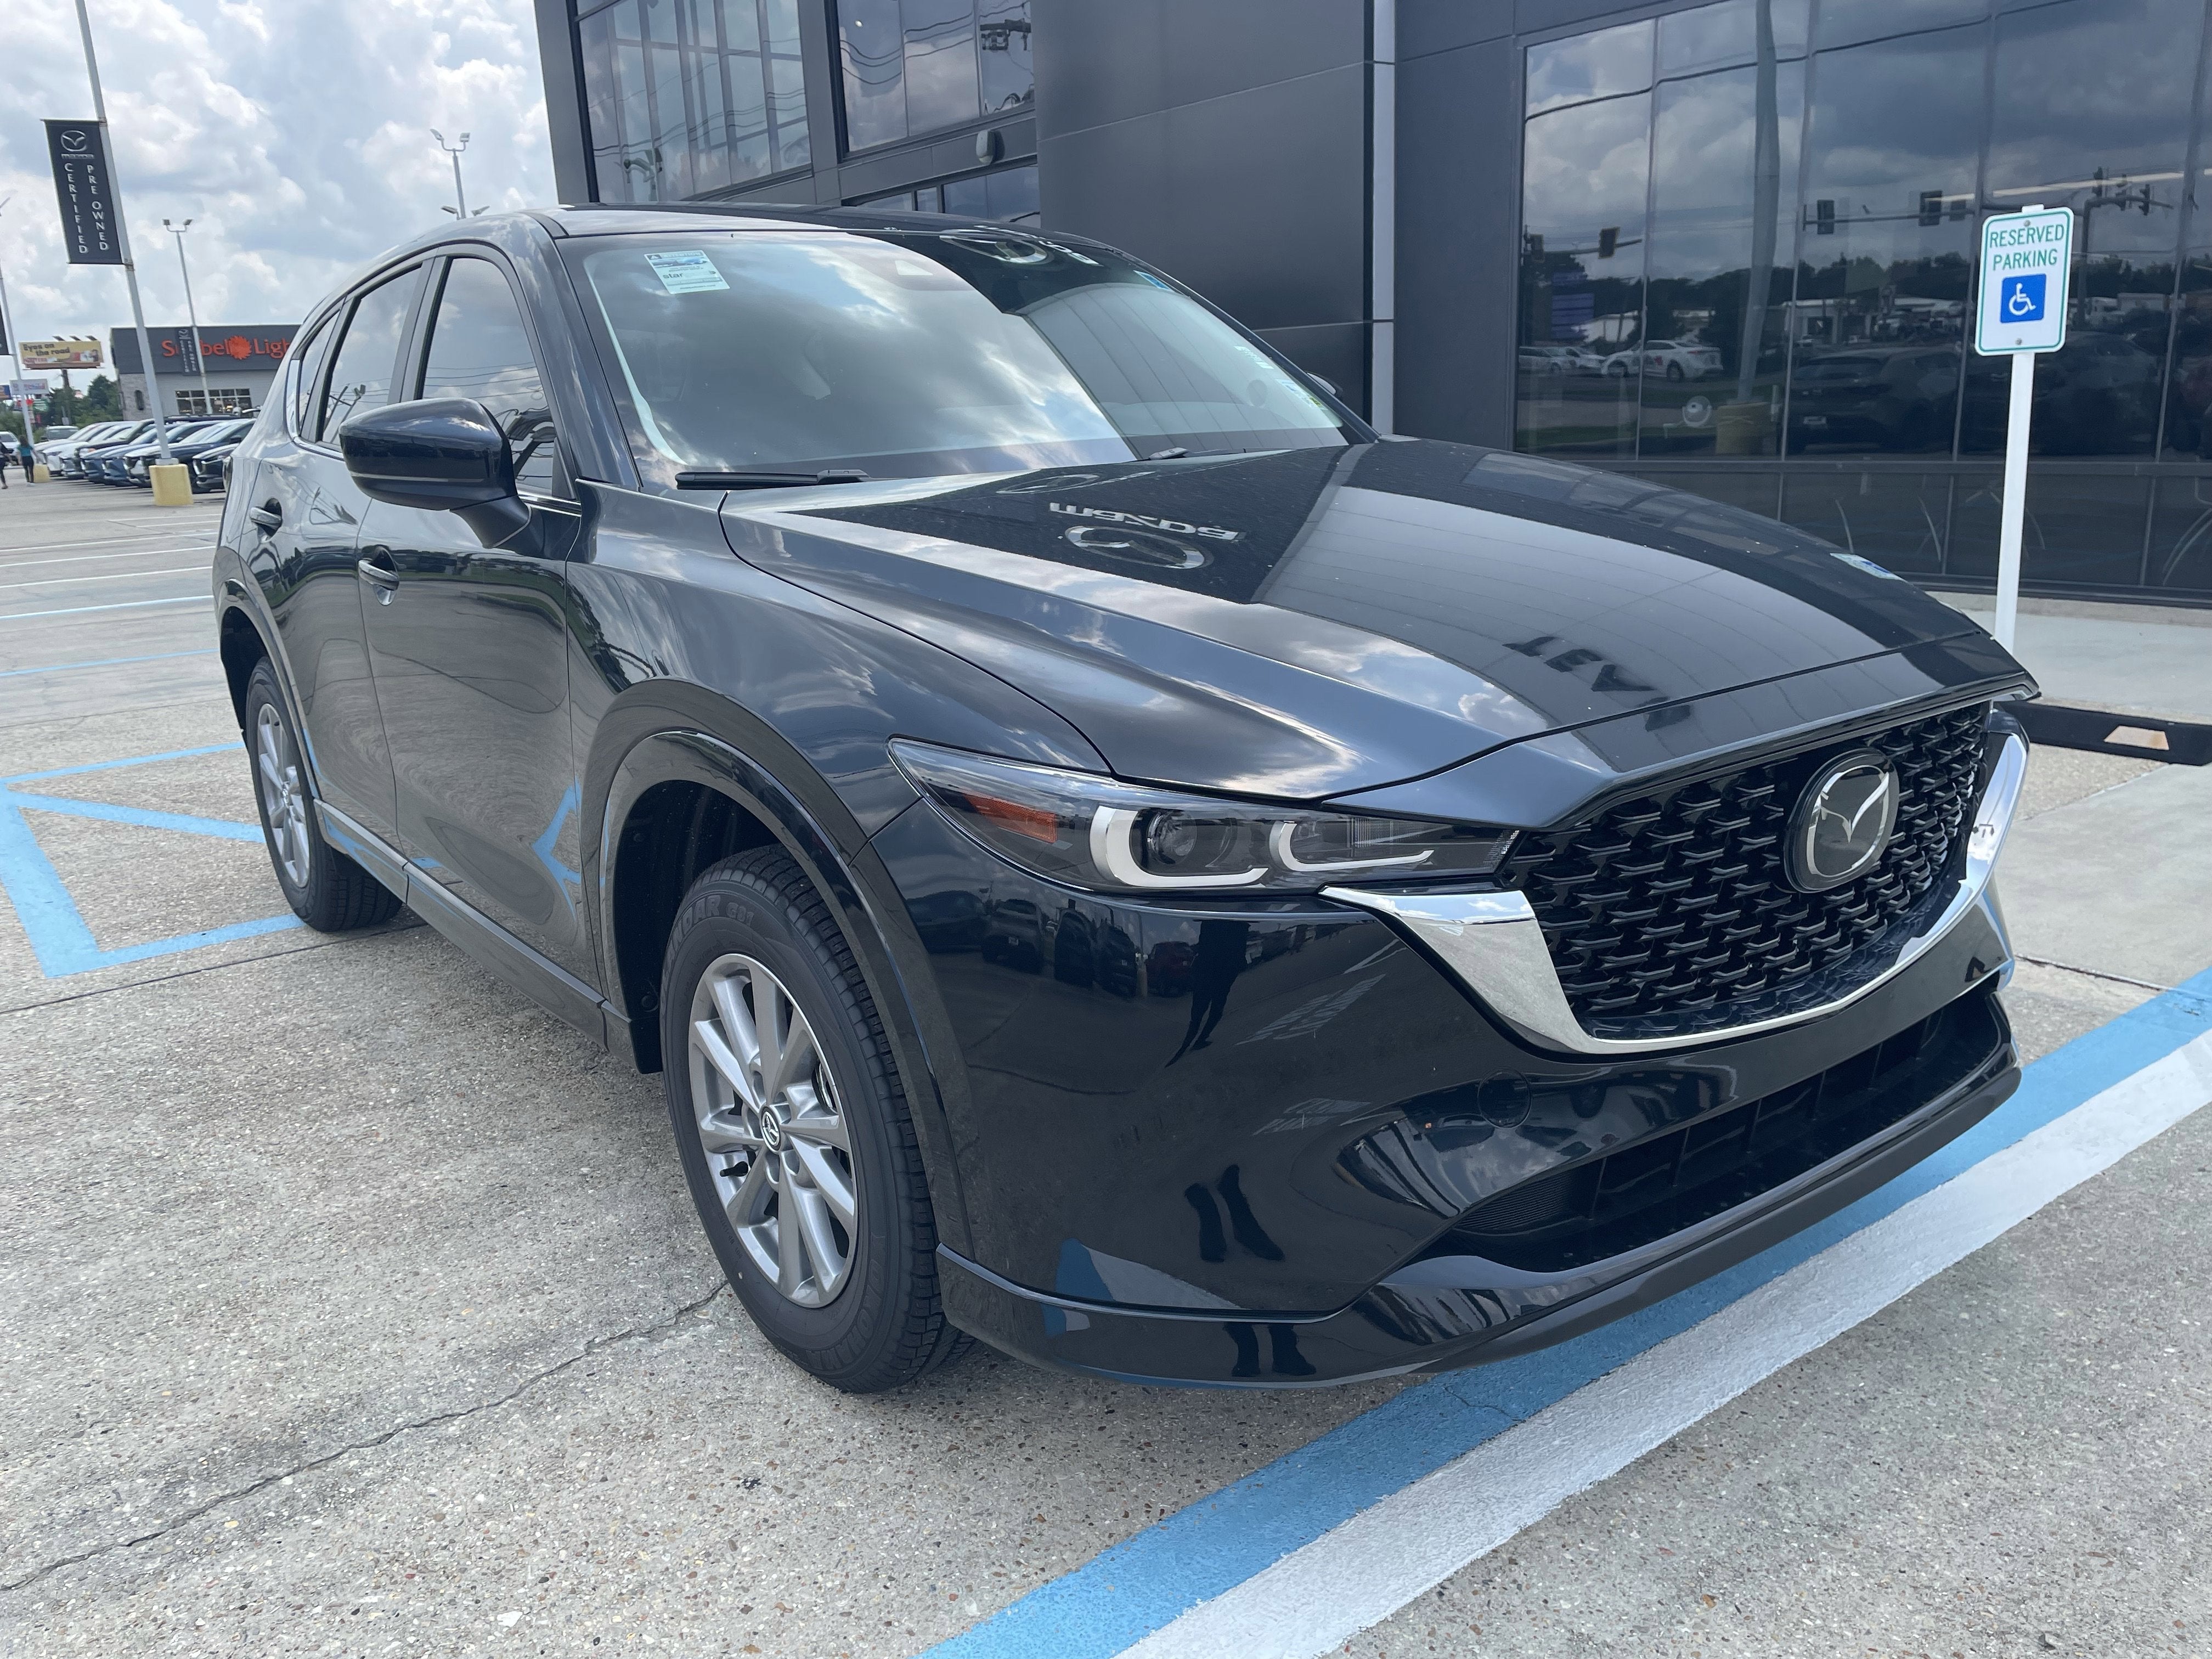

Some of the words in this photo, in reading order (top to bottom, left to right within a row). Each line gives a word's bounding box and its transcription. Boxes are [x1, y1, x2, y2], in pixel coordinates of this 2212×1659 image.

[64, 163, 88, 253] CERTIFIED
[87, 165, 97, 195] PRE
[92, 201, 109, 251] OWNED
[1990, 224, 2064, 249] RESERVED
[1993, 249, 2057, 271] PARKING
